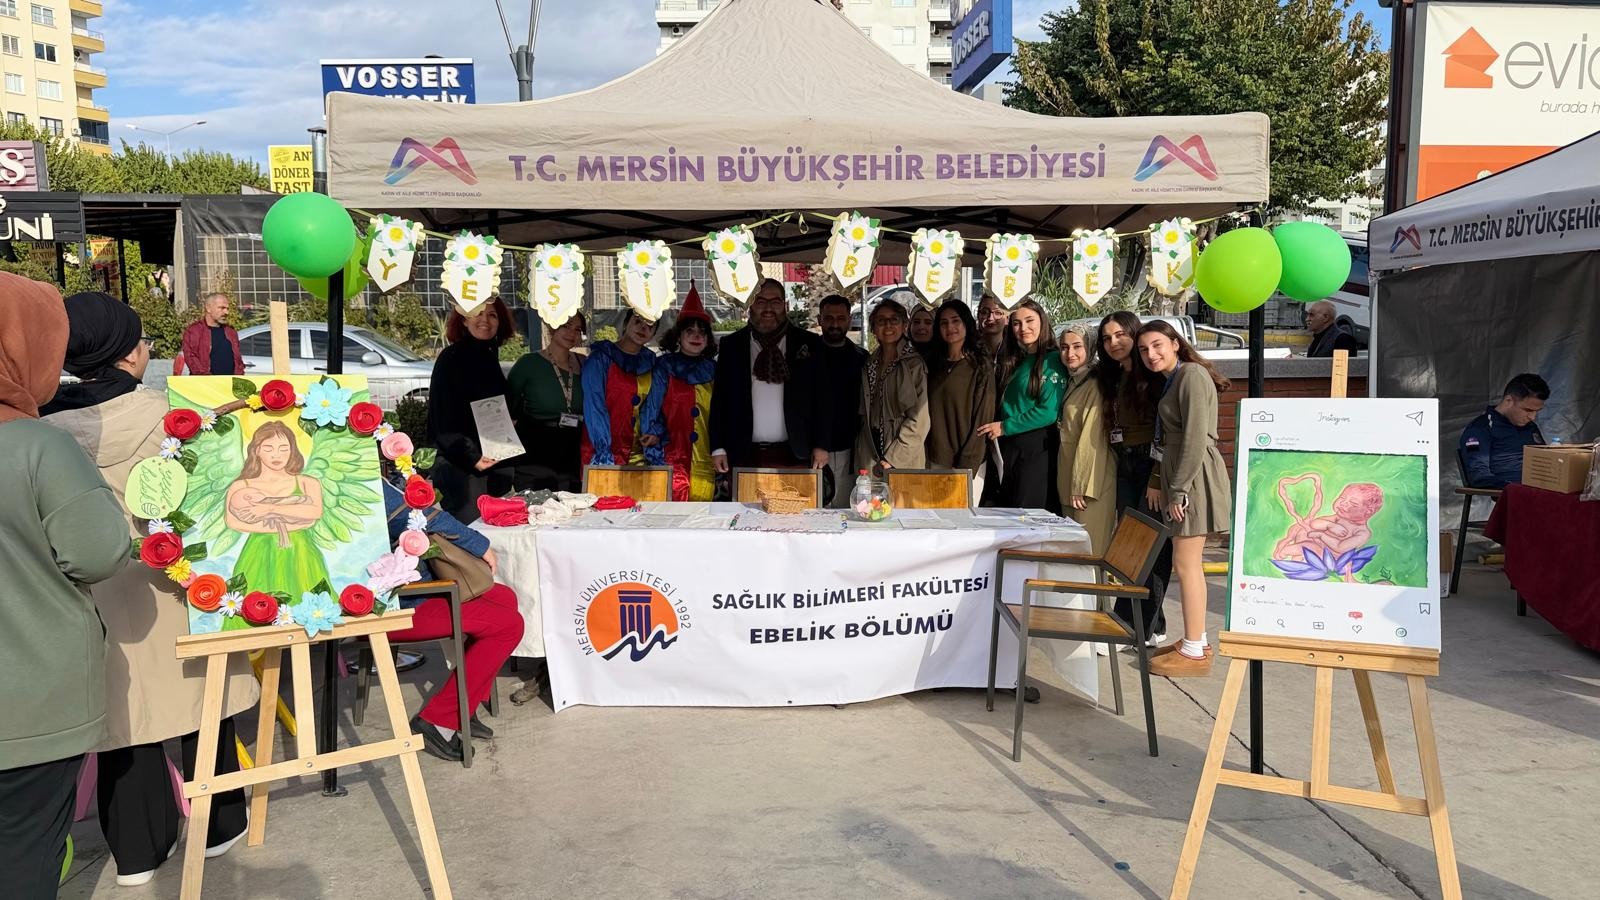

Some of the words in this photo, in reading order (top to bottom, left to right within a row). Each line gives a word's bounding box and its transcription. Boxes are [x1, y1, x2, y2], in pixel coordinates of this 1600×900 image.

[336, 66, 461, 89] VOSSER
[1503, 33, 1600, 90] evi
[1540, 100, 1588, 114] burada
[273, 165, 310, 179] DÖNER
[293, 151, 312, 162] AN
[509, 155, 567, 182] T.C.
[577, 146, 705, 182] MERSİN
[718, 146, 925, 189] BÜYÜKŞEHİR
[936, 143, 1105, 180] BELEDİYESİ
[274, 181, 310, 194] FAST
[1429, 228, 1448, 247] T.C.
[1450, 214, 1502, 245] MERSİN
[1505, 199, 1600, 238] BÜYÜKŞEHİR
[579, 569, 677, 602] ÜNİVERSİTESİ
[712, 588, 787, 610] SAĞLIK
[793, 581, 885, 609] BİLİMLERİ
[892, 572, 989, 599] FAKÜLTESİ
[573, 604, 595, 656] MERSİN
[673, 598, 692, 630] 1992
[750, 621, 836, 644] EBELİK
[844, 608, 954, 639] BÖLÜMÜ
